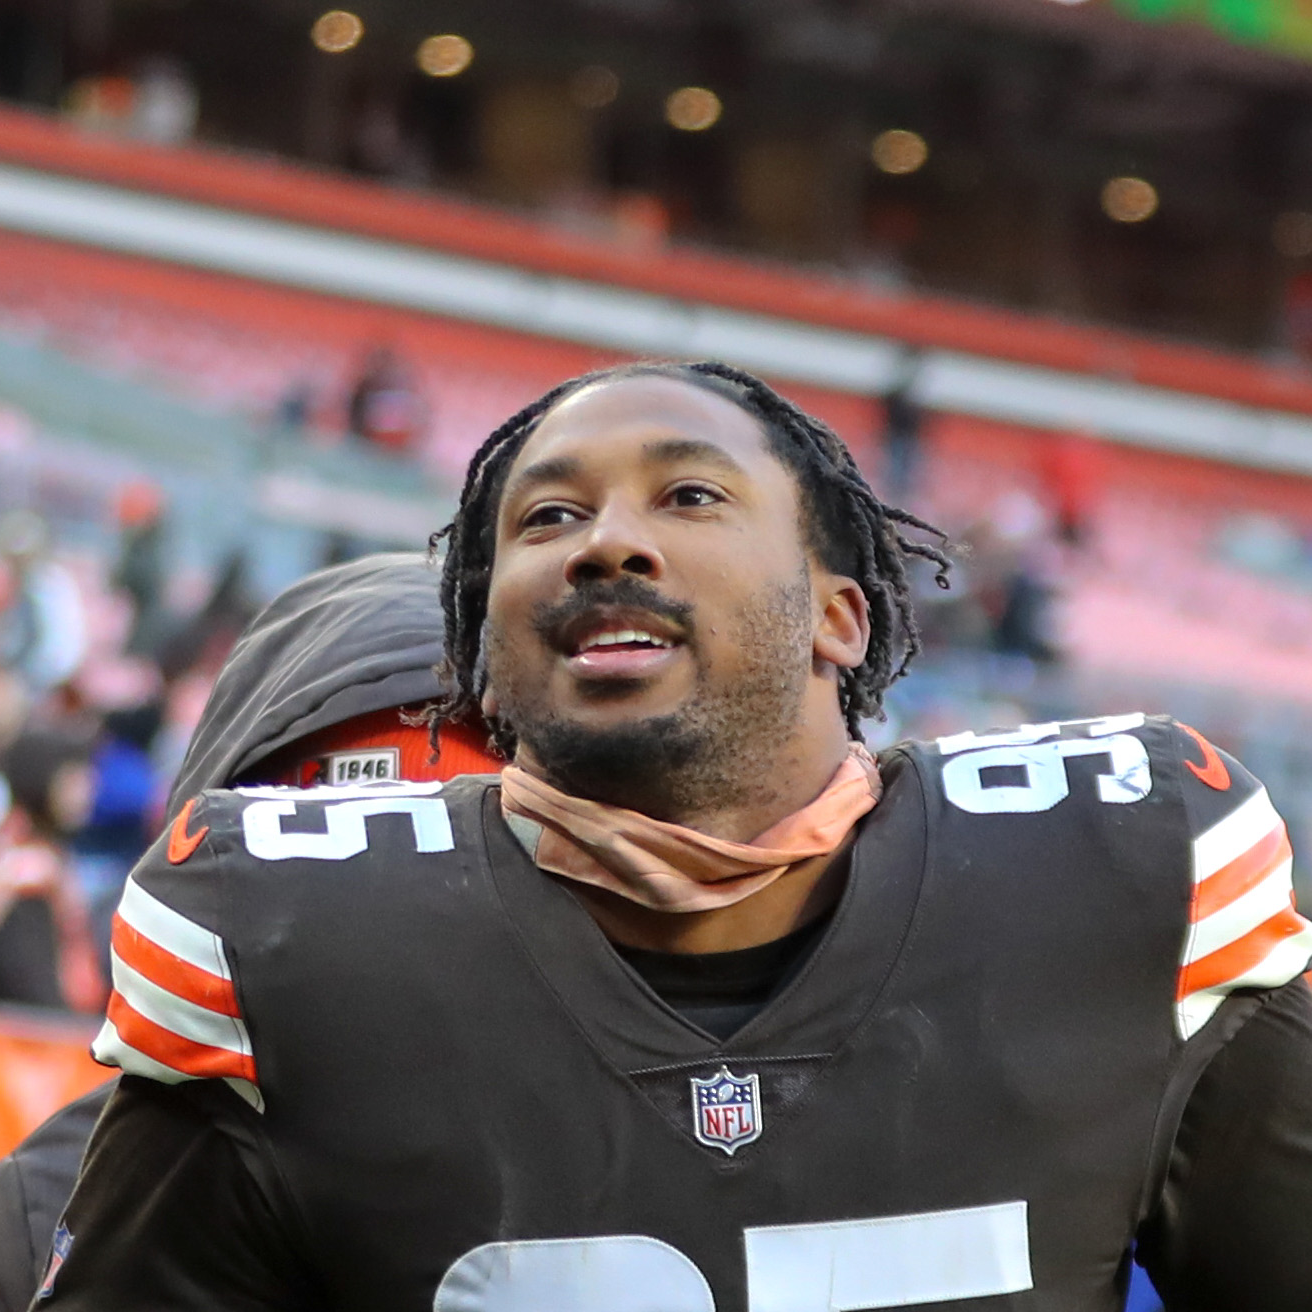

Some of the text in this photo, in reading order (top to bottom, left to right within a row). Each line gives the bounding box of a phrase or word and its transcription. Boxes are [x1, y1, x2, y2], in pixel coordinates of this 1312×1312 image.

[338, 759, 389, 781] 1946
[236, 781, 456, 861] 5
[705, 1106, 750, 1138] NFL
